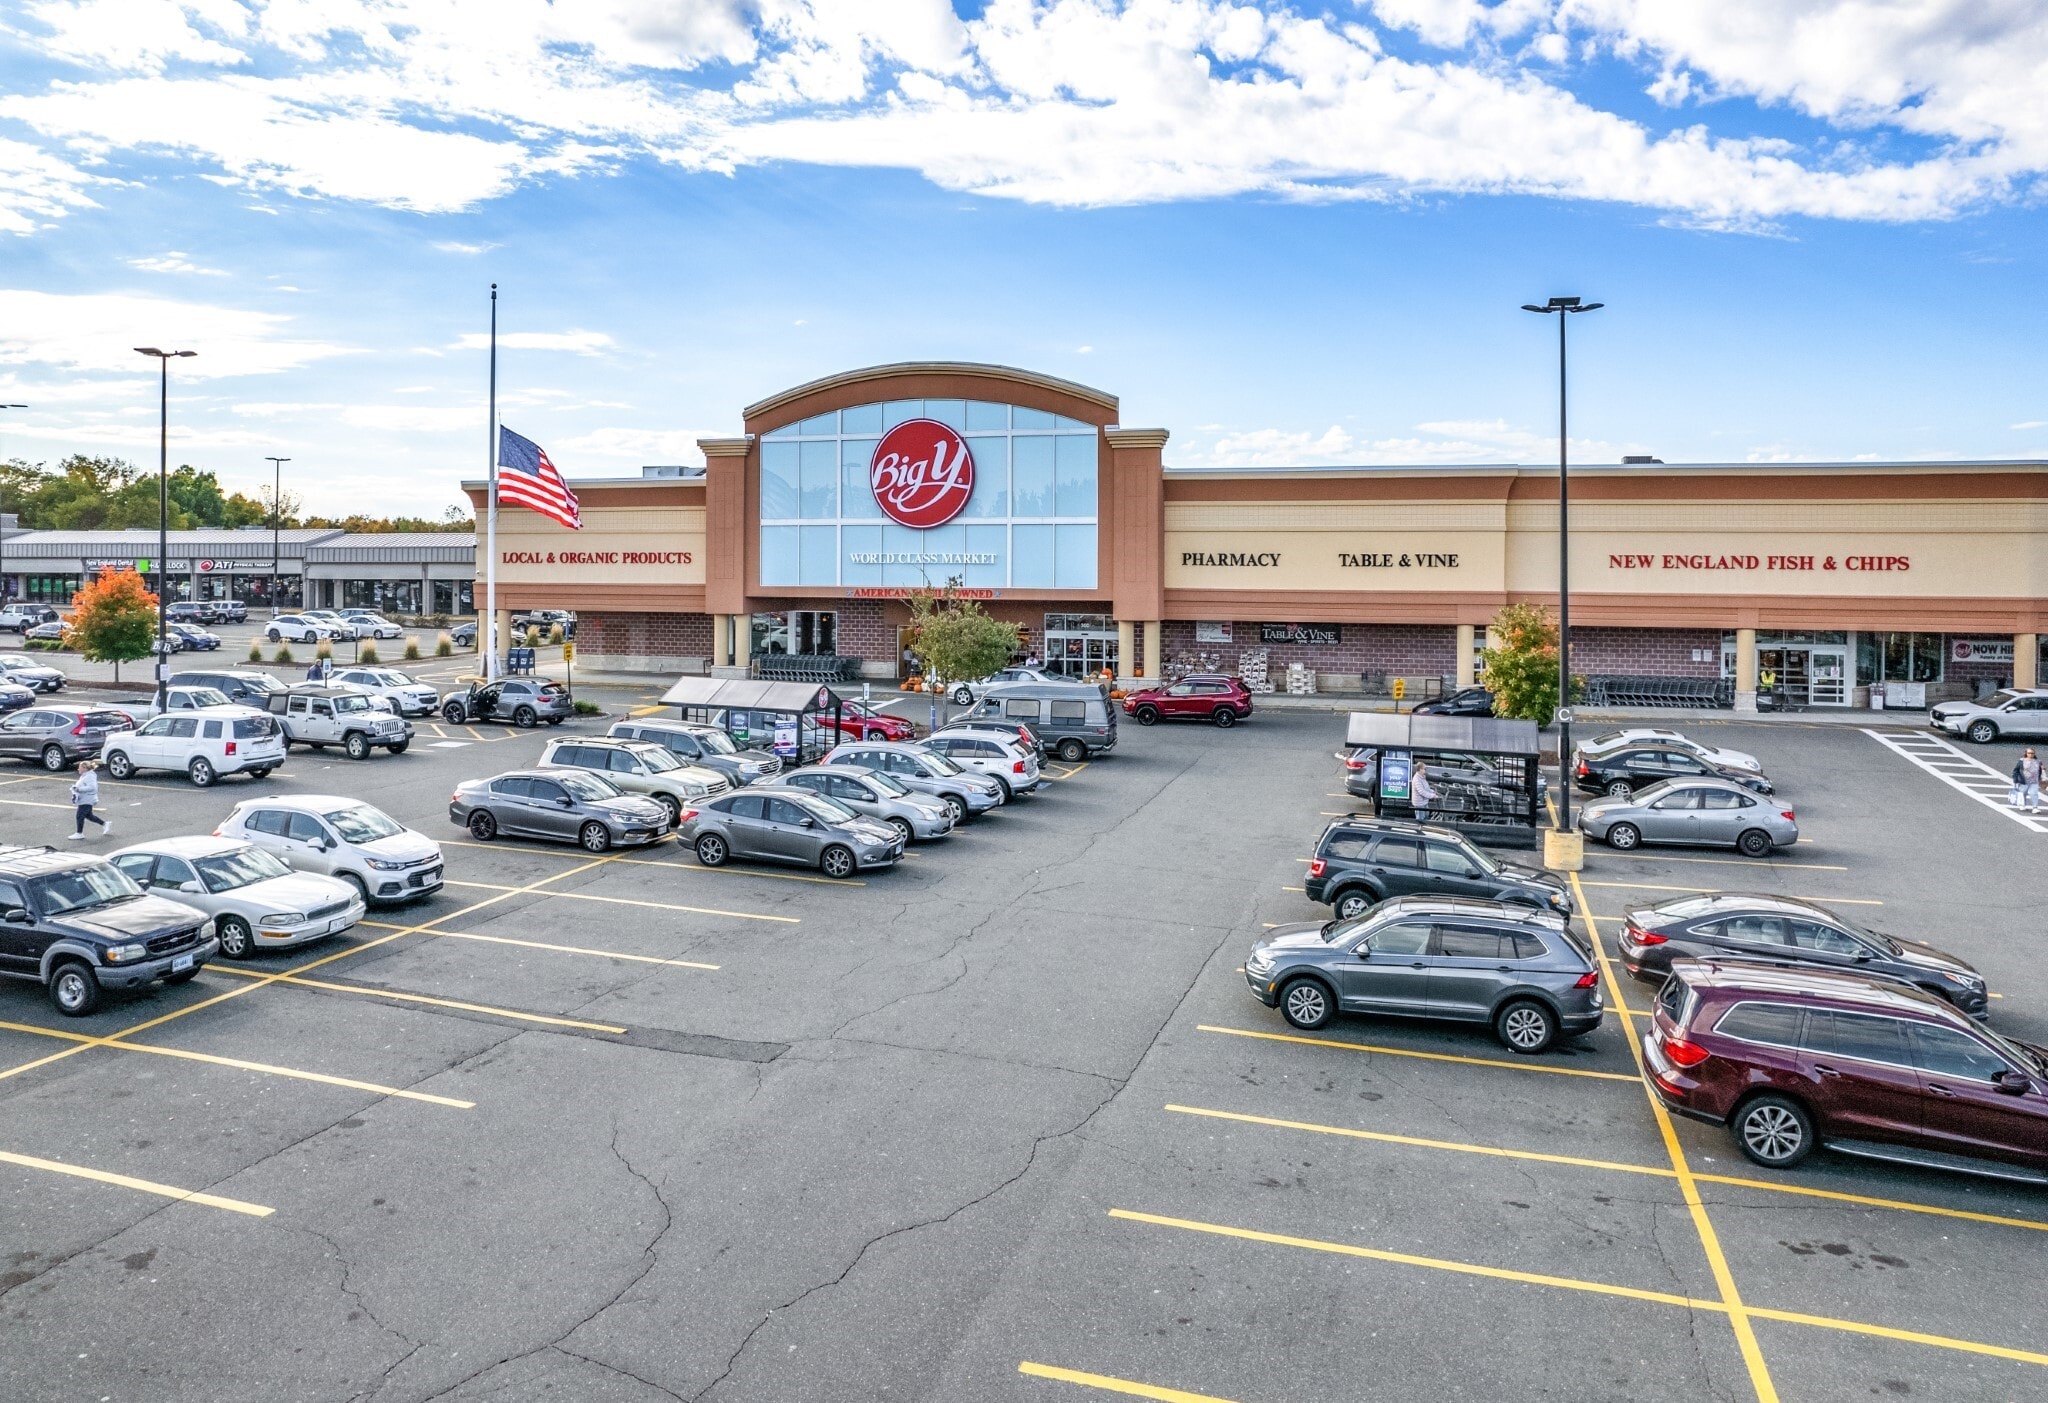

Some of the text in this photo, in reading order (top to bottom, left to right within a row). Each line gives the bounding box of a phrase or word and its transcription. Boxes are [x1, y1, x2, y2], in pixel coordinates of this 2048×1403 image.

[873, 452, 929, 503] Big
[502, 552, 692, 564] LOCAL & ORGANIC PRODUCTS
[850, 553, 997, 564] WORLD CLASS MARKET
[1181, 552, 1281, 567] PHARMACY
[1338, 553, 1459, 568] TABLE & VINE
[1609, 554, 1910, 571] NEW ENGLAND FISH & CHIPS
[214, 561, 234, 569] ATI
[853, 588, 909, 599] AMERICAN
[953, 589, 994, 599] OWNED
[1294, 626, 1308, 640] &
[1973, 644, 1998, 654] NOW
